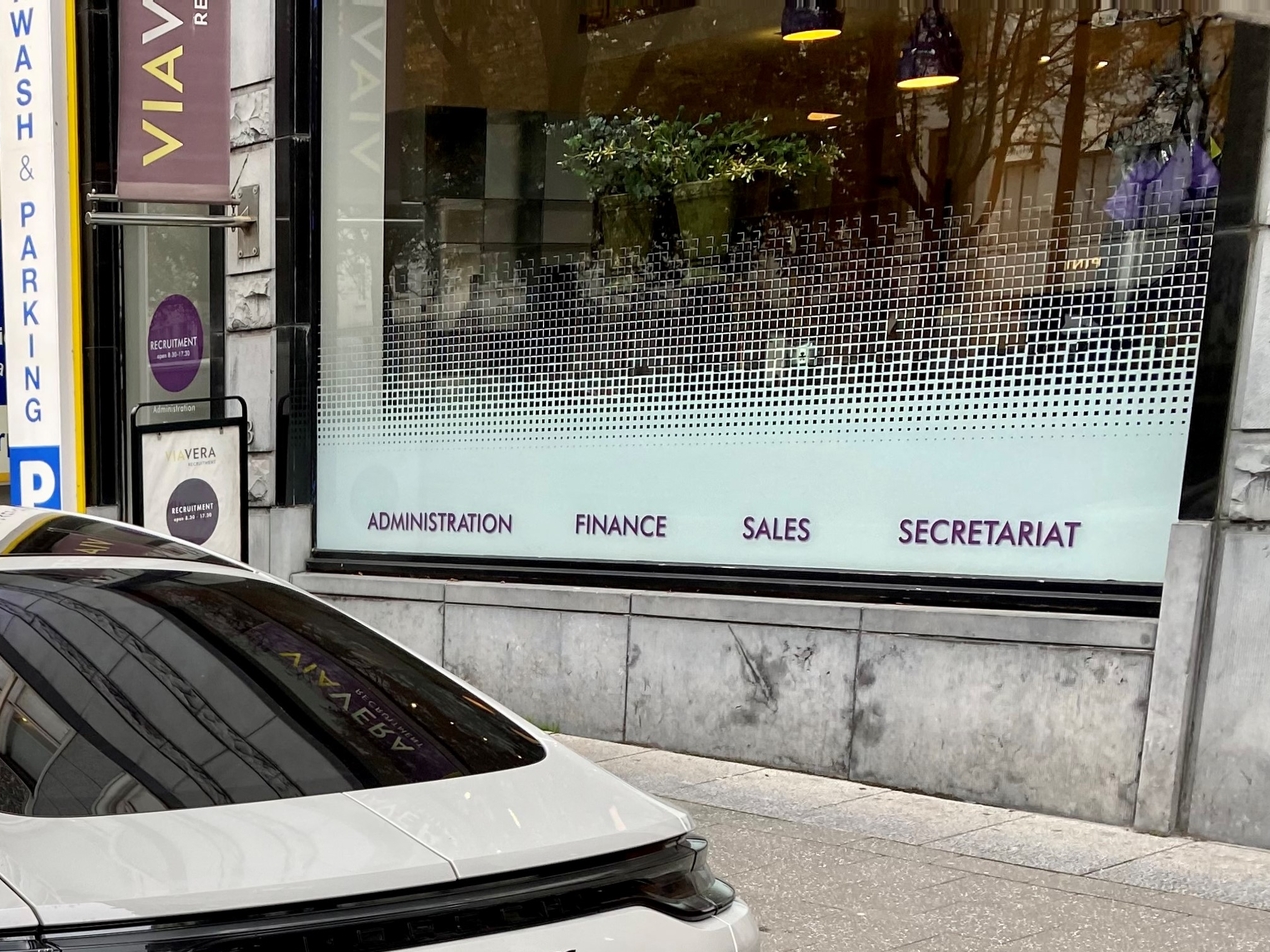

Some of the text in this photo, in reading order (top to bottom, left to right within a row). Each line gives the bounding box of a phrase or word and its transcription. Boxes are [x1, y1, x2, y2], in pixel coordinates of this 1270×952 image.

[19, 154, 35, 181] &
[19, 201, 42, 422] PARKING
[150, 336, 197, 350] RECRUITMENT
[153, 403, 196, 414] Administration
[165, 446, 216, 462] VIAVERA
[19, 459, 55, 508] P
[171, 502, 214, 515] RECRUITMENT
[367, 512, 513, 534] ADMINISTRATION
[575, 514, 668, 538] FINANCE
[742, 516, 811, 542] SALES
[898, 518, 1082, 548] SECRETARIAT
